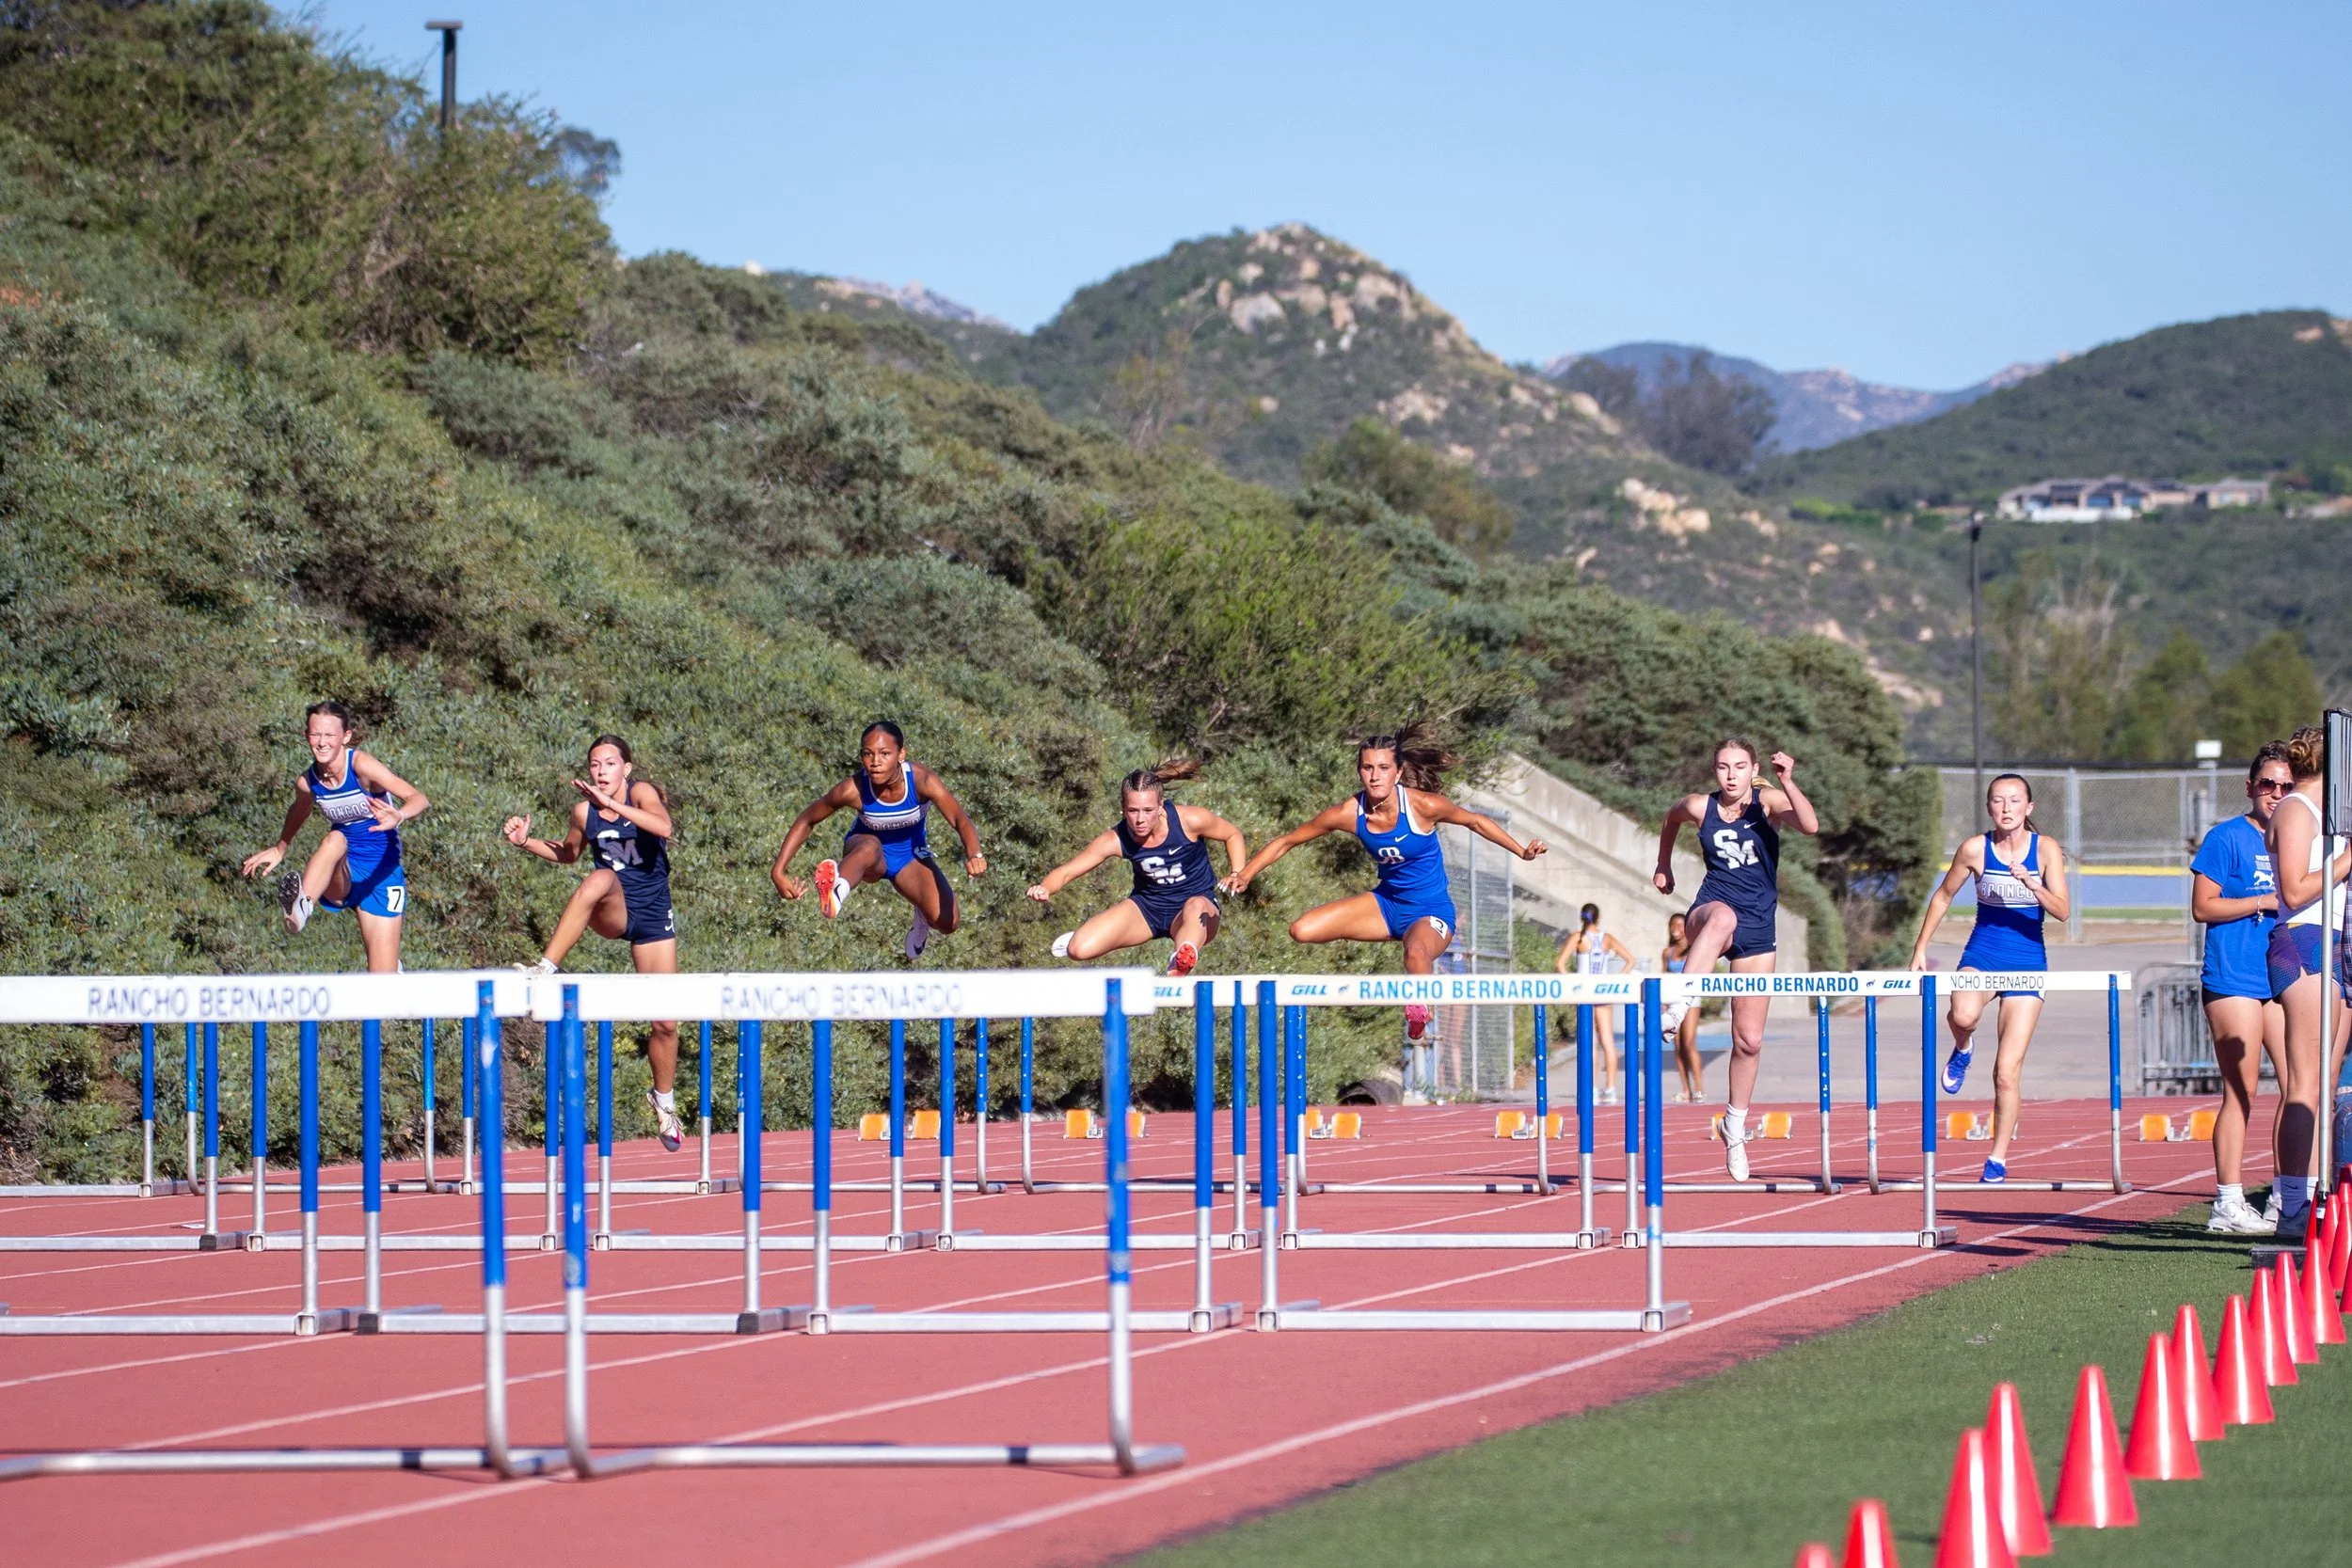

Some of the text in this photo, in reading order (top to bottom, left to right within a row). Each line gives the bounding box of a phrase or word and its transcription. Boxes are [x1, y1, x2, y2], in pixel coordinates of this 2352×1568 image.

[391, 888, 402, 911] 7
[1980, 881, 2033, 899] BRONCO
[1291, 984, 1327, 996] GILL
[1359, 979, 1630, 999] RANCHO BERNARDO GILL
[1702, 976, 1912, 992] RANCHO BERNARDO GILL
[1951, 975, 2044, 989] NCHO BERNARDO
[88, 987, 330, 1017] RANCHO BERNARDO
[722, 985, 961, 1017] RANCHO BERNARDO
